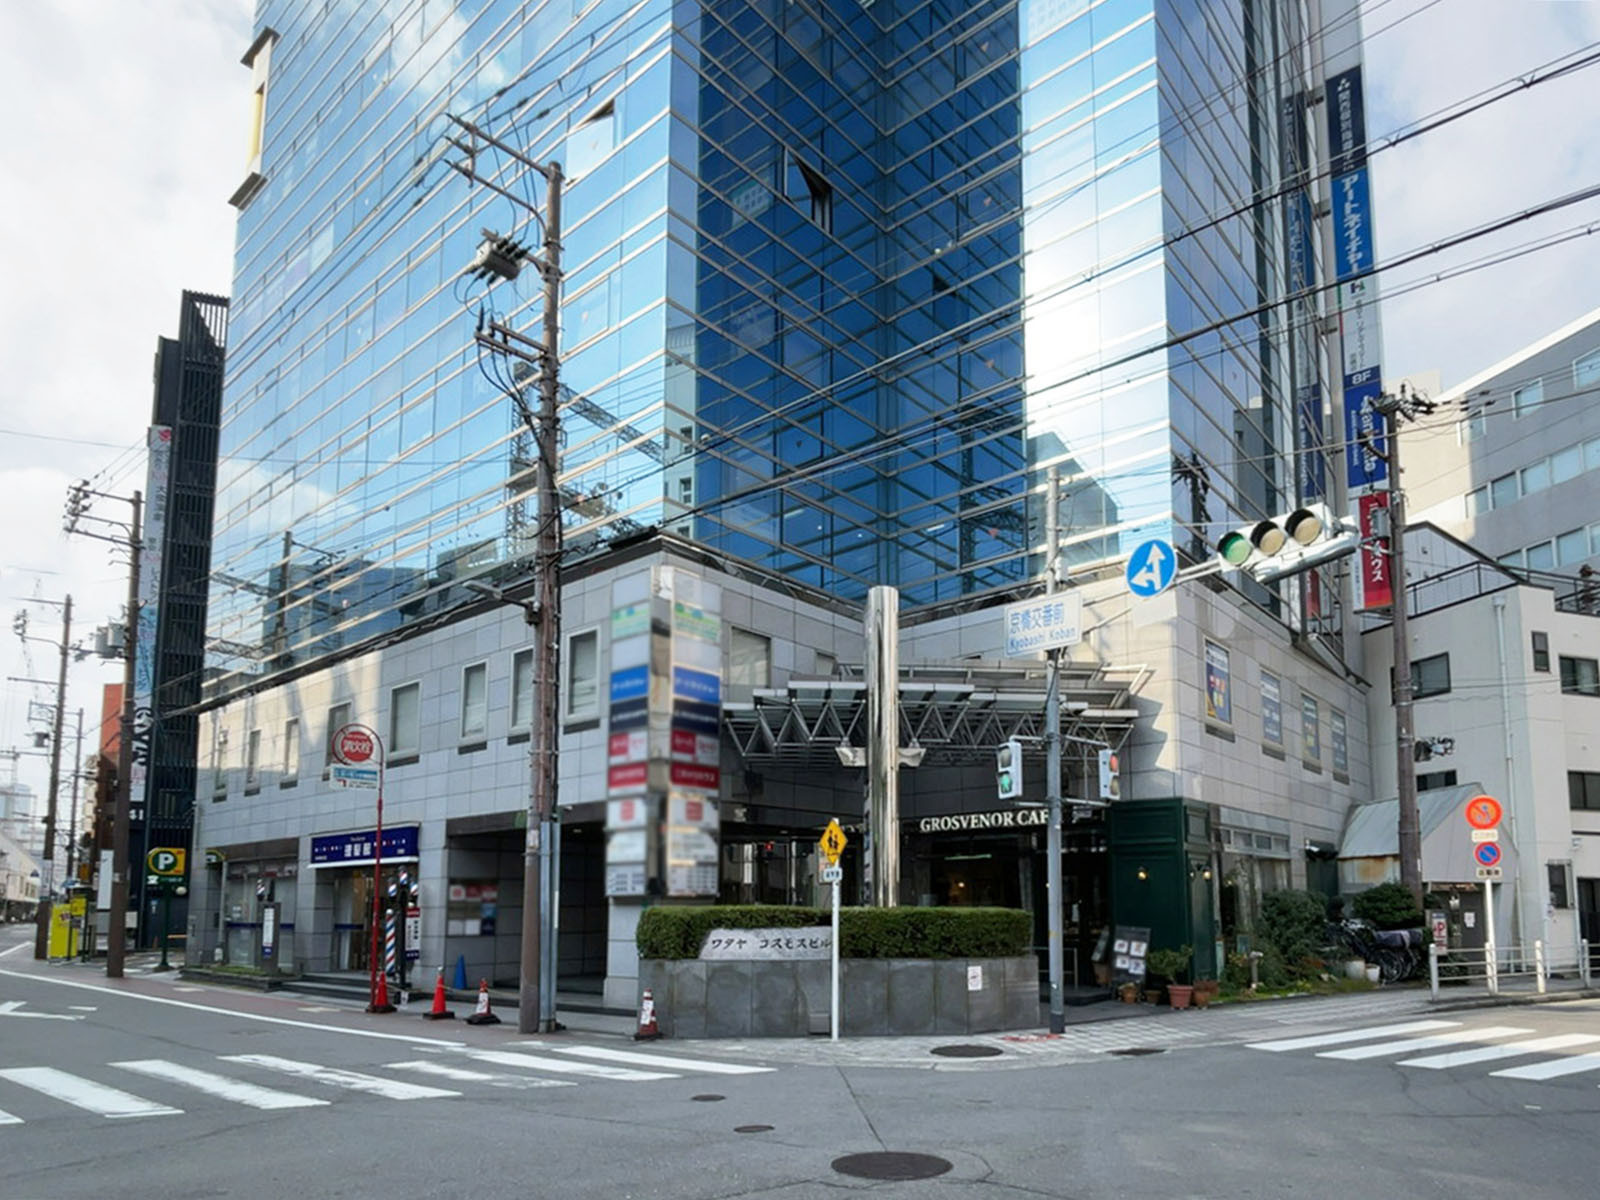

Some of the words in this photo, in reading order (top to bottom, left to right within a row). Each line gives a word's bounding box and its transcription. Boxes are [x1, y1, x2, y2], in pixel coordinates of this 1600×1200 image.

[1352, 370, 1371, 385] 8F
[1010, 602, 1064, 634] 京橋交番前
[919, 811, 1014, 833] GROSVENOR
[1016, 808, 1049, 826] CAF
[158, 853, 175, 870] P
[711, 938, 747, 950] ワタヤ
[759, 936, 832, 950] コスモスビル
